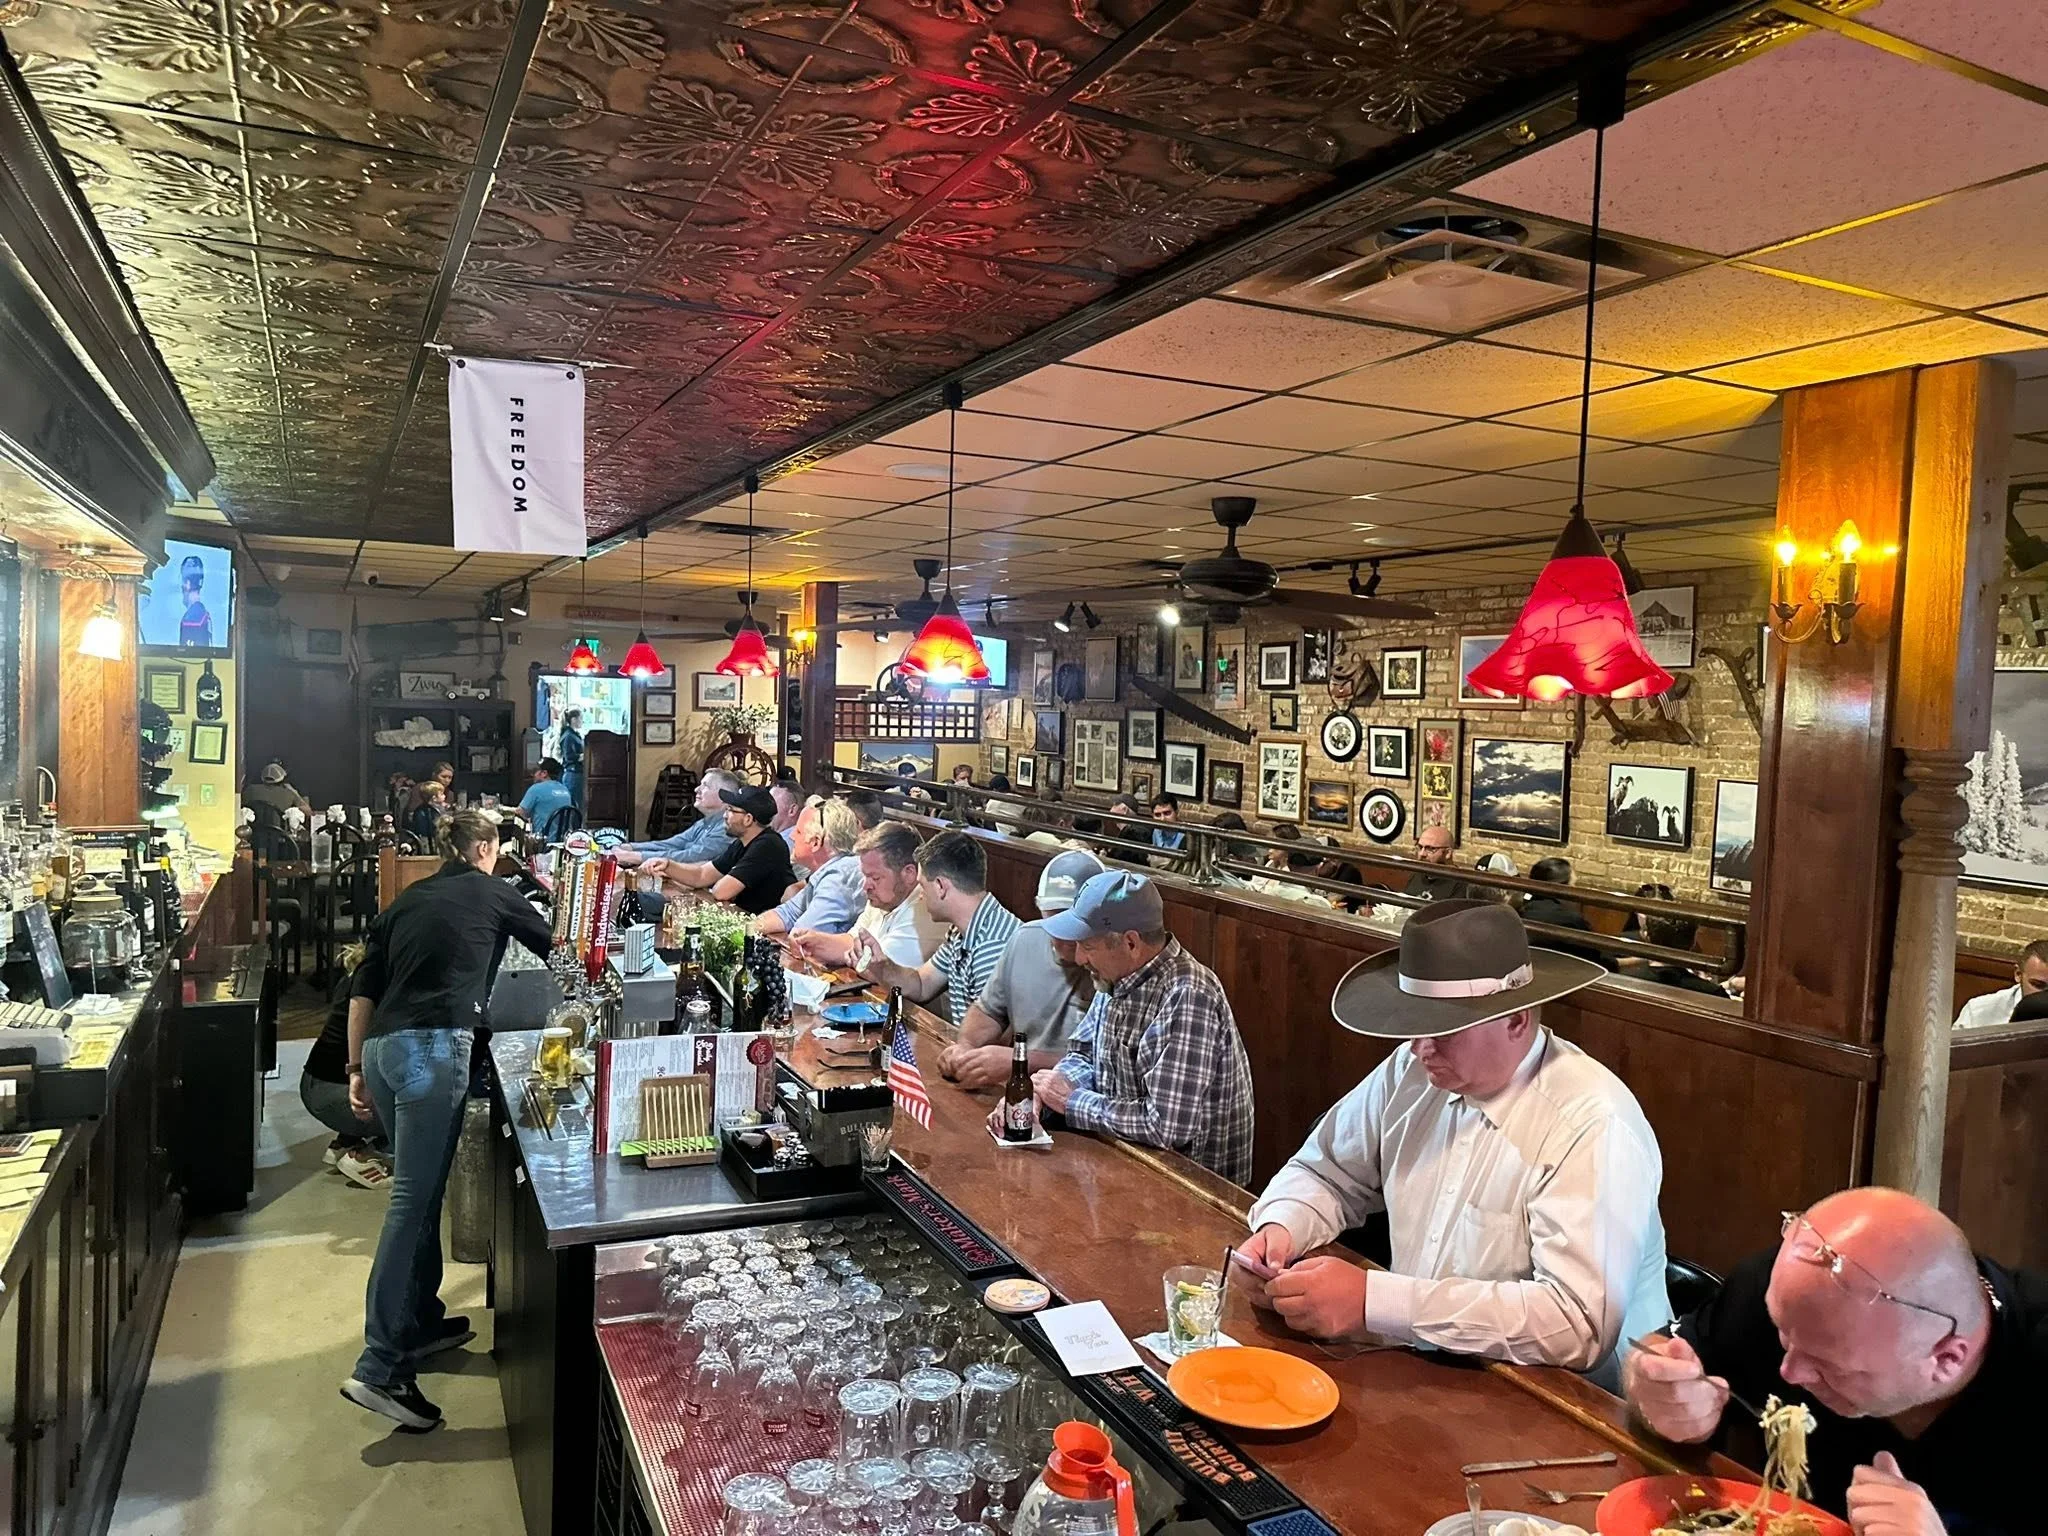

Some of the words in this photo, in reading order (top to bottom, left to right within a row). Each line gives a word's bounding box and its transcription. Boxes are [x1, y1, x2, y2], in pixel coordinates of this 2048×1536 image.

[509, 397, 528, 513] FREEDOM
[594, 827, 625, 838] NEVADA
[594, 882, 613, 947] Budweiser
[886, 1174, 921, 1203] Mark
[920, 1199, 979, 1251] Maker's
[1164, 1429, 1233, 1485] BULLEIT
[1179, 1421, 1258, 1483] BOURBON
